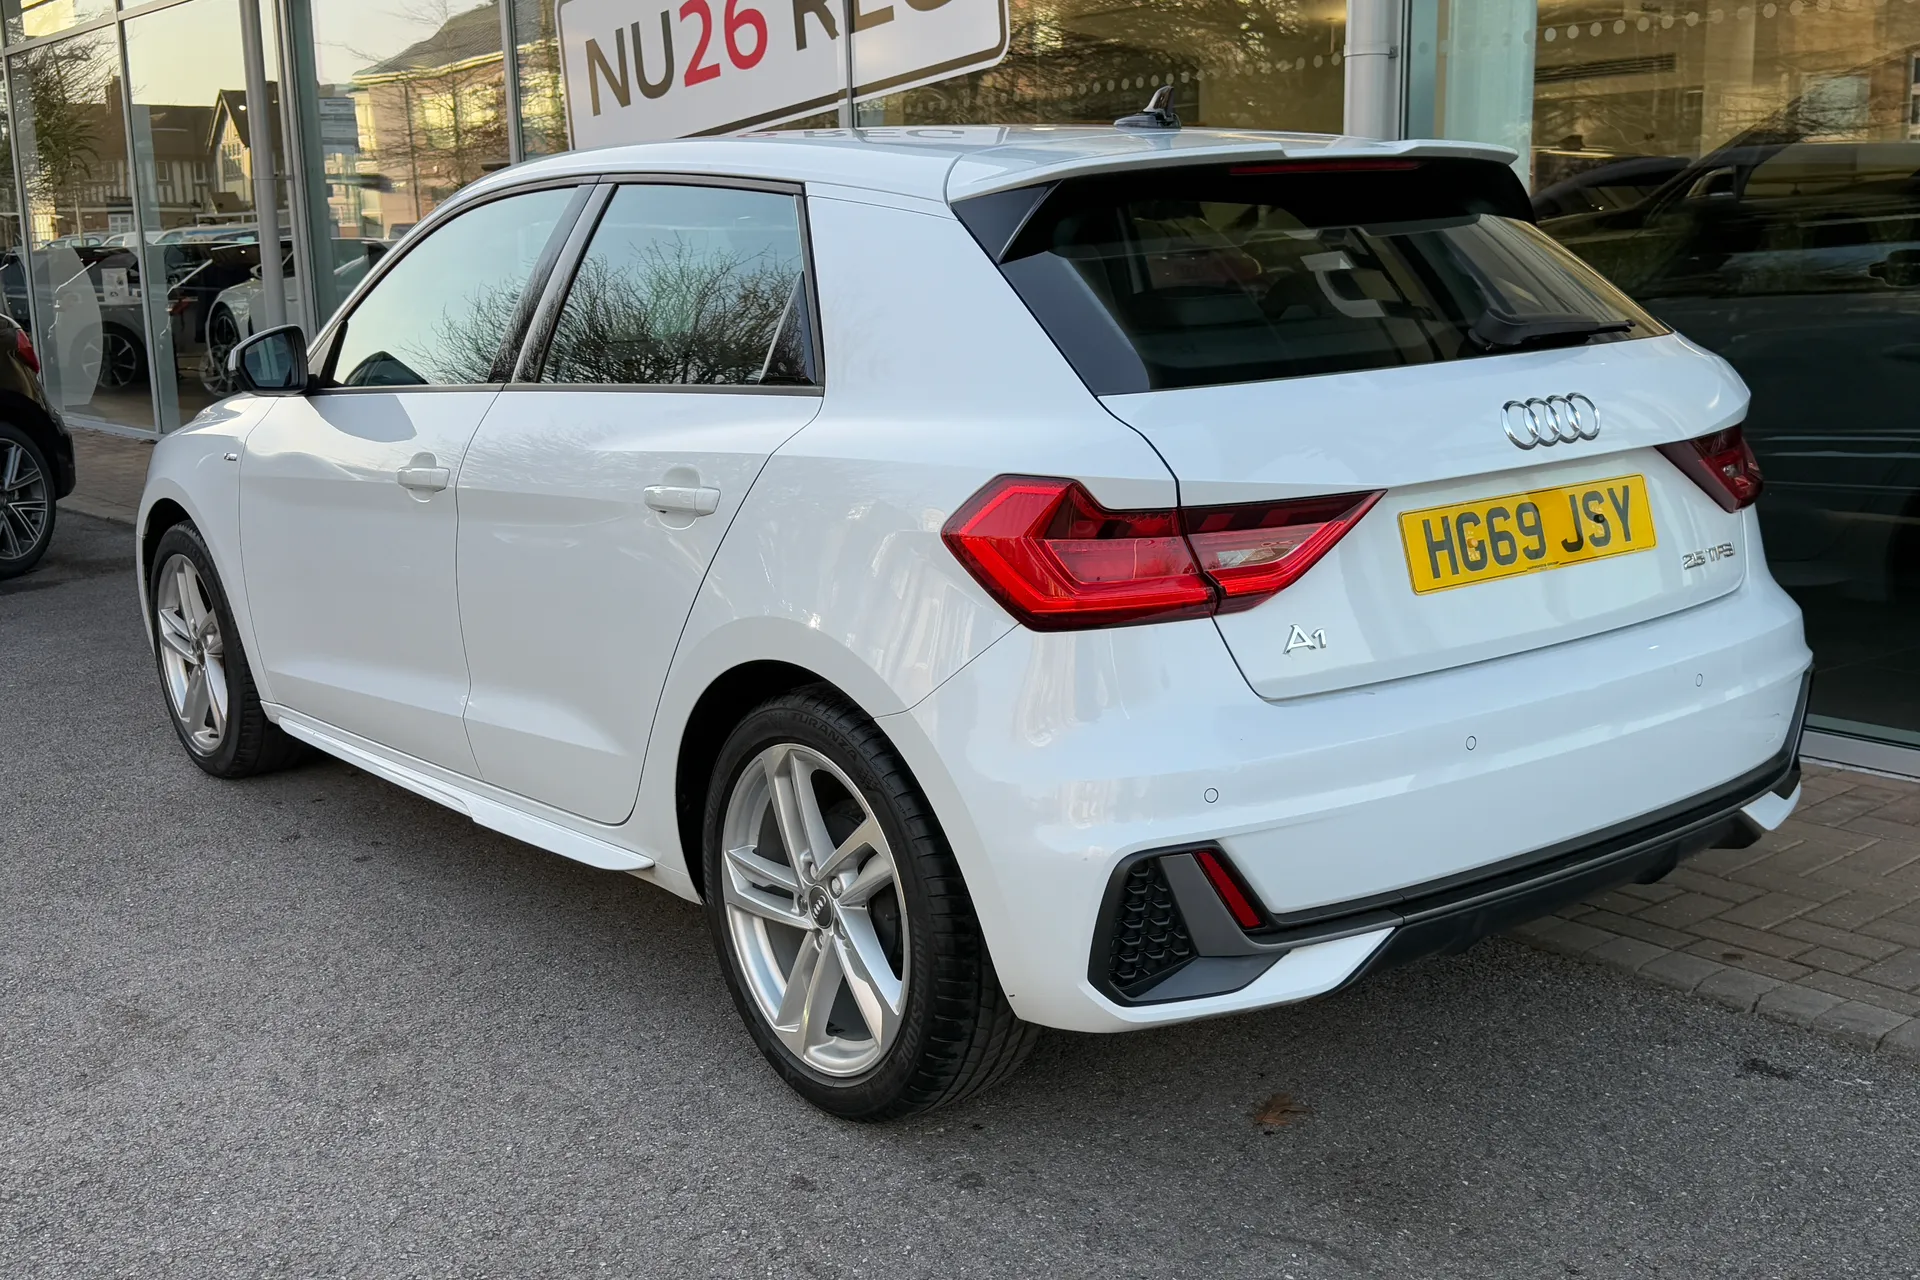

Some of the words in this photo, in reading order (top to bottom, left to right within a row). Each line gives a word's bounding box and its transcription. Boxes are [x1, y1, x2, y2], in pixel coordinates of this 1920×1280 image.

[585, 0, 768, 117] NU26
[1422, 502, 1547, 579] HG69
[1561, 485, 1632, 553] JSY
[1682, 550, 1706, 570] 25
[1283, 624, 1326, 654] A1
[791, 712, 858, 761] TURANZA
